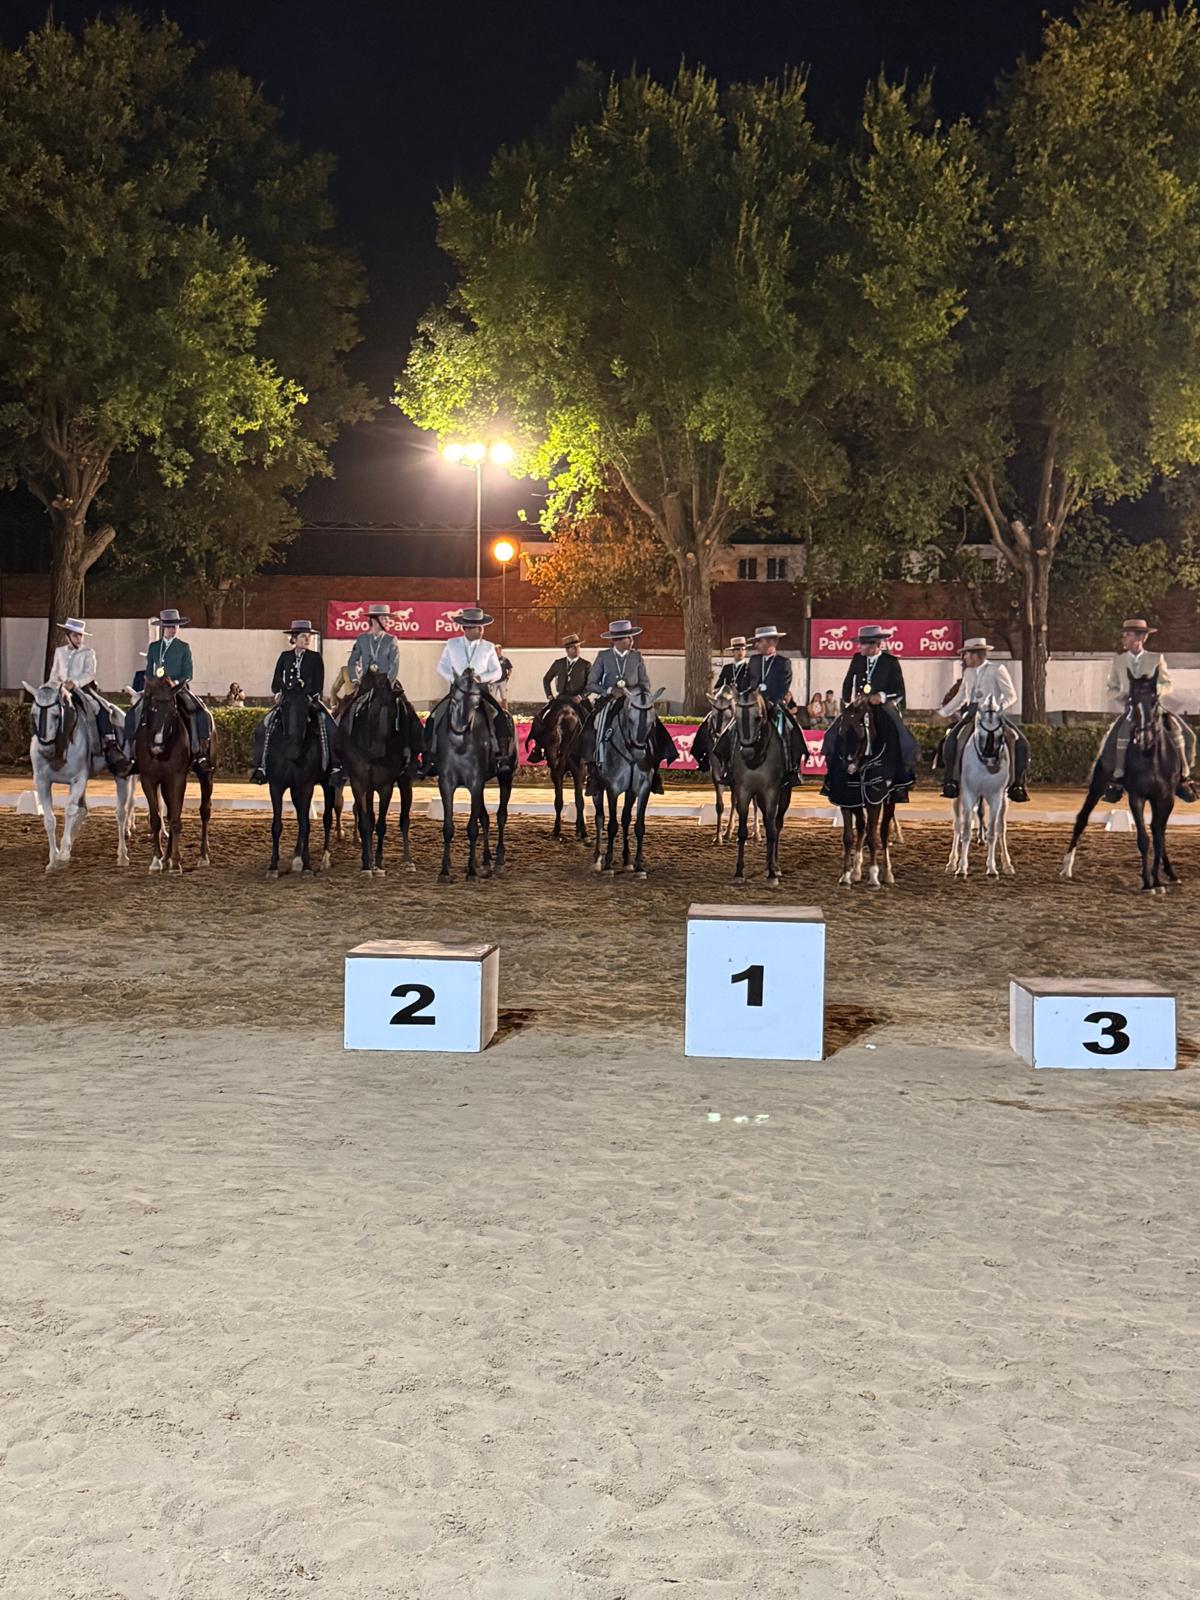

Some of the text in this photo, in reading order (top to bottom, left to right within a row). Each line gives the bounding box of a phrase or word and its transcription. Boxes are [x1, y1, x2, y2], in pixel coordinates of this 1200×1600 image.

[336, 618, 370, 631] Pavo
[435, 619, 465, 632] Pav
[818, 637, 954, 651] Pavo avo Pavo
[389, 983, 436, 1026] 2
[731, 965, 764, 1007] 1
[1082, 1010, 1131, 1055] 3
